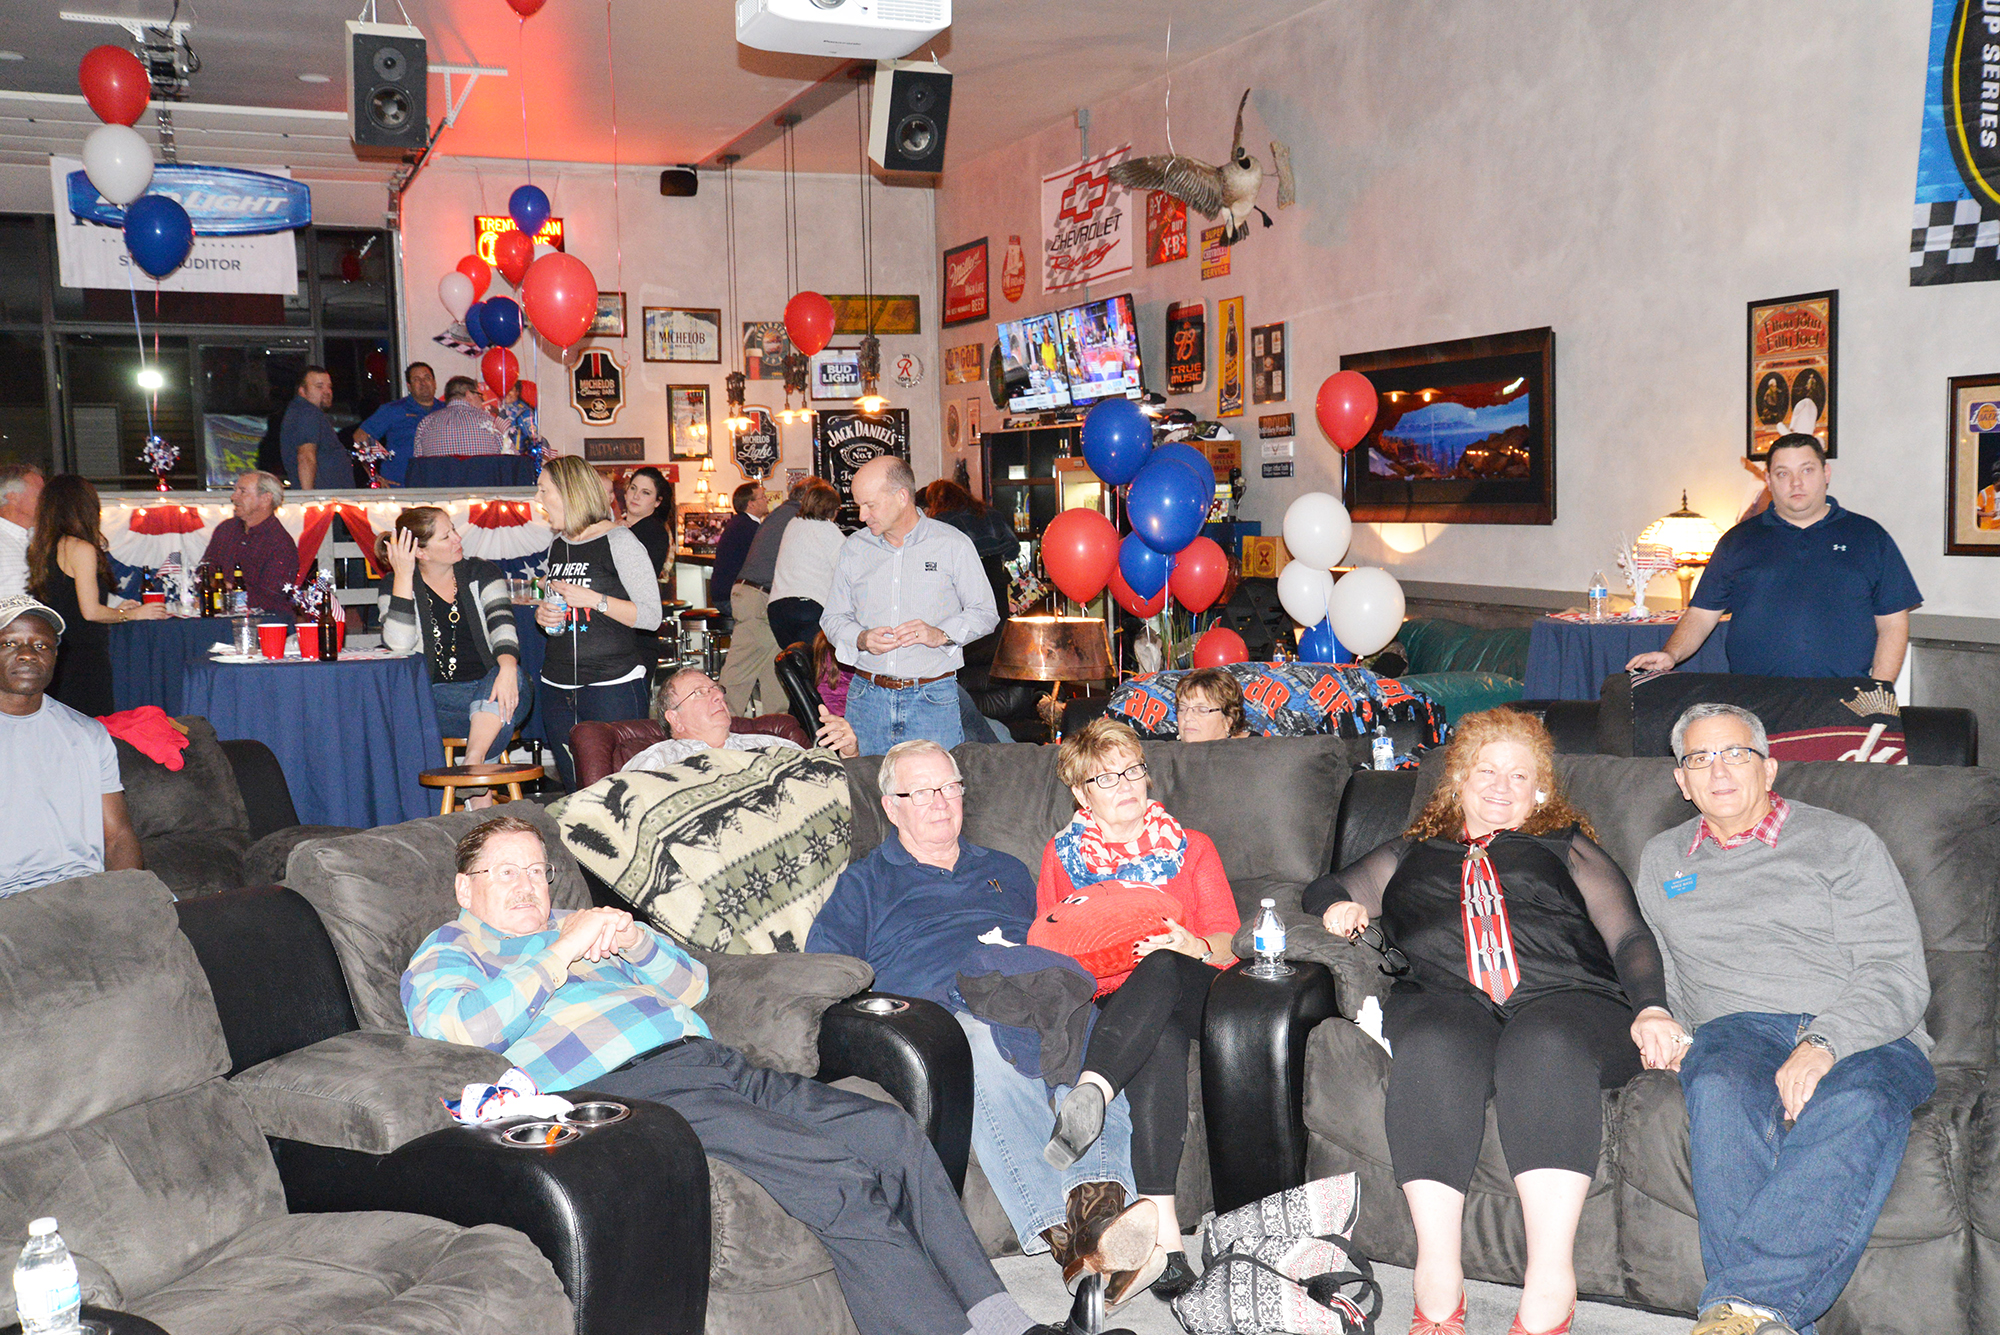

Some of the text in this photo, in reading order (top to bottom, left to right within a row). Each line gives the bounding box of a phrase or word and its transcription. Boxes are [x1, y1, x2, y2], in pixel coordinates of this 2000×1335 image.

[1980, 43, 2000, 149] SERIES
[185, 191, 288, 213] LIGHT
[1050, 212, 1123, 251] CHEVROLET
[1171, 219, 1184, 232] BUY
[1050, 239, 1121, 273] Racing
[178, 257, 241, 271] UDITOR
[948, 250, 983, 288] Miller
[1203, 264, 1229, 279] SERVICE
[659, 331, 706, 345] MICHELOB
[827, 365, 852, 374] BUD
[1170, 362, 1202, 375] TRUE
[580, 379, 615, 389] MICHELOB
[822, 373, 857, 383] LIGHT
[1171, 372, 1202, 384] MUSIC
[742, 435, 770, 444] MICHELOB
[827, 424, 854, 448] JACK
[738, 443, 774, 461] Light
[549, 562, 590, 577] I'M HERE
